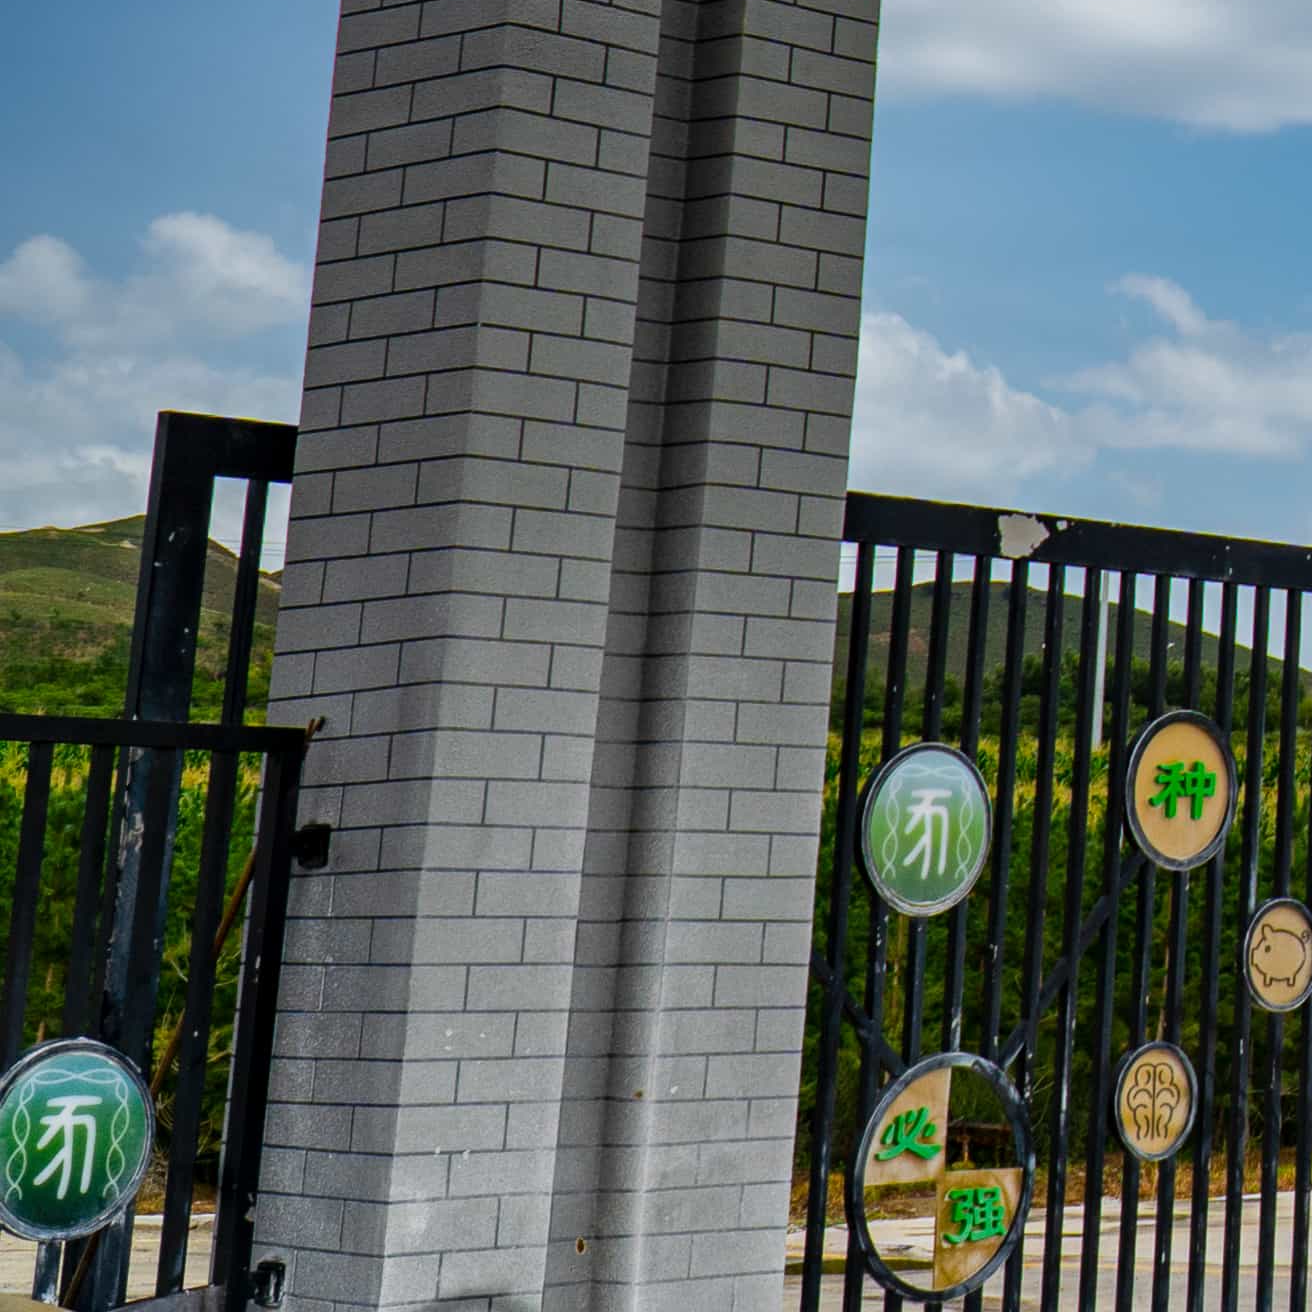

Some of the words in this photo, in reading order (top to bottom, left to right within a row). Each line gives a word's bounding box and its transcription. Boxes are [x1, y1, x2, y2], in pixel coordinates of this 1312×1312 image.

[1148, 760, 1216, 820] 种
[875, 1105, 944, 1163] 必
[941, 1186, 1007, 1245] 强
